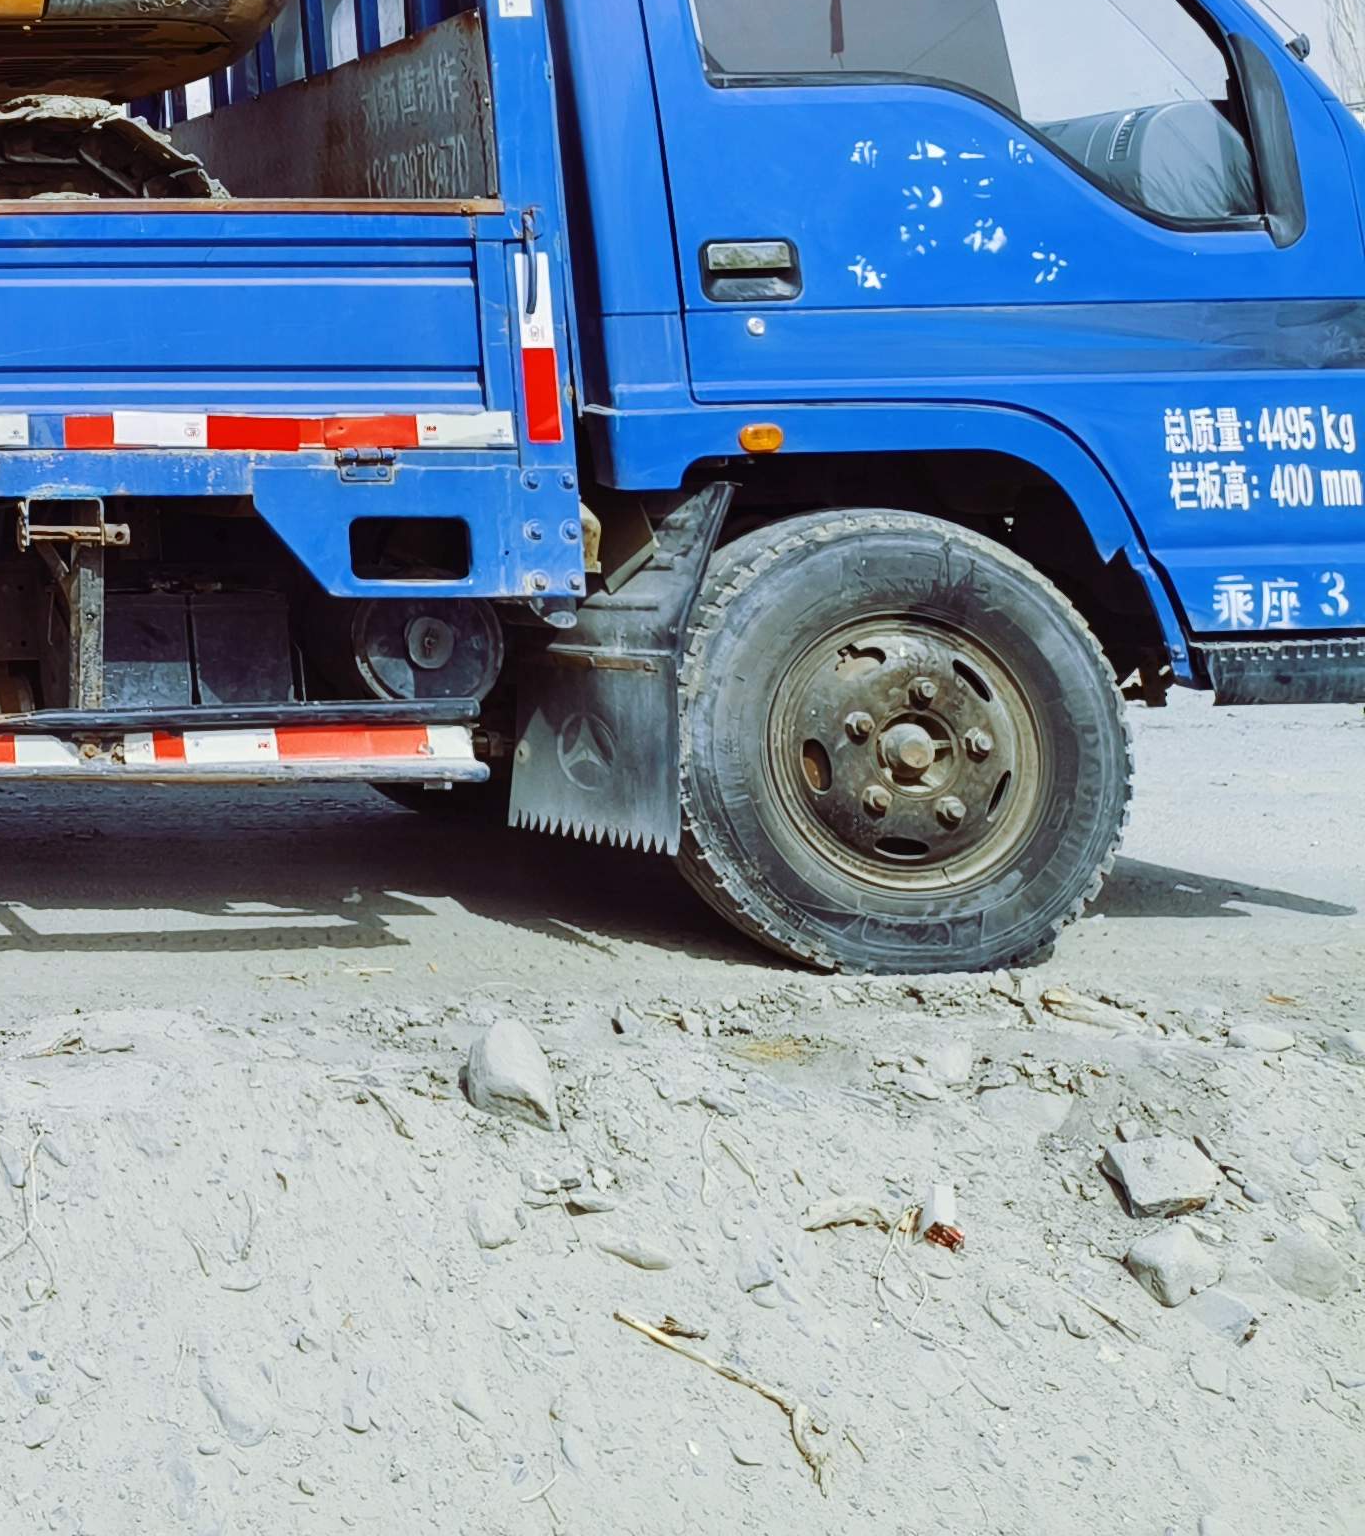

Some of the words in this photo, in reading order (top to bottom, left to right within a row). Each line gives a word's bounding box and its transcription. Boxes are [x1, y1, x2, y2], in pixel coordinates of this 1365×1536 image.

[1258, 406, 1316, 450] 4495
[1321, 405, 1356, 453] kg
[1270, 464, 1313, 507] 400
[1320, 469, 1363, 506] mm
[1212, 575, 1301, 628] 乘座
[1320, 571, 1349, 616] 3
